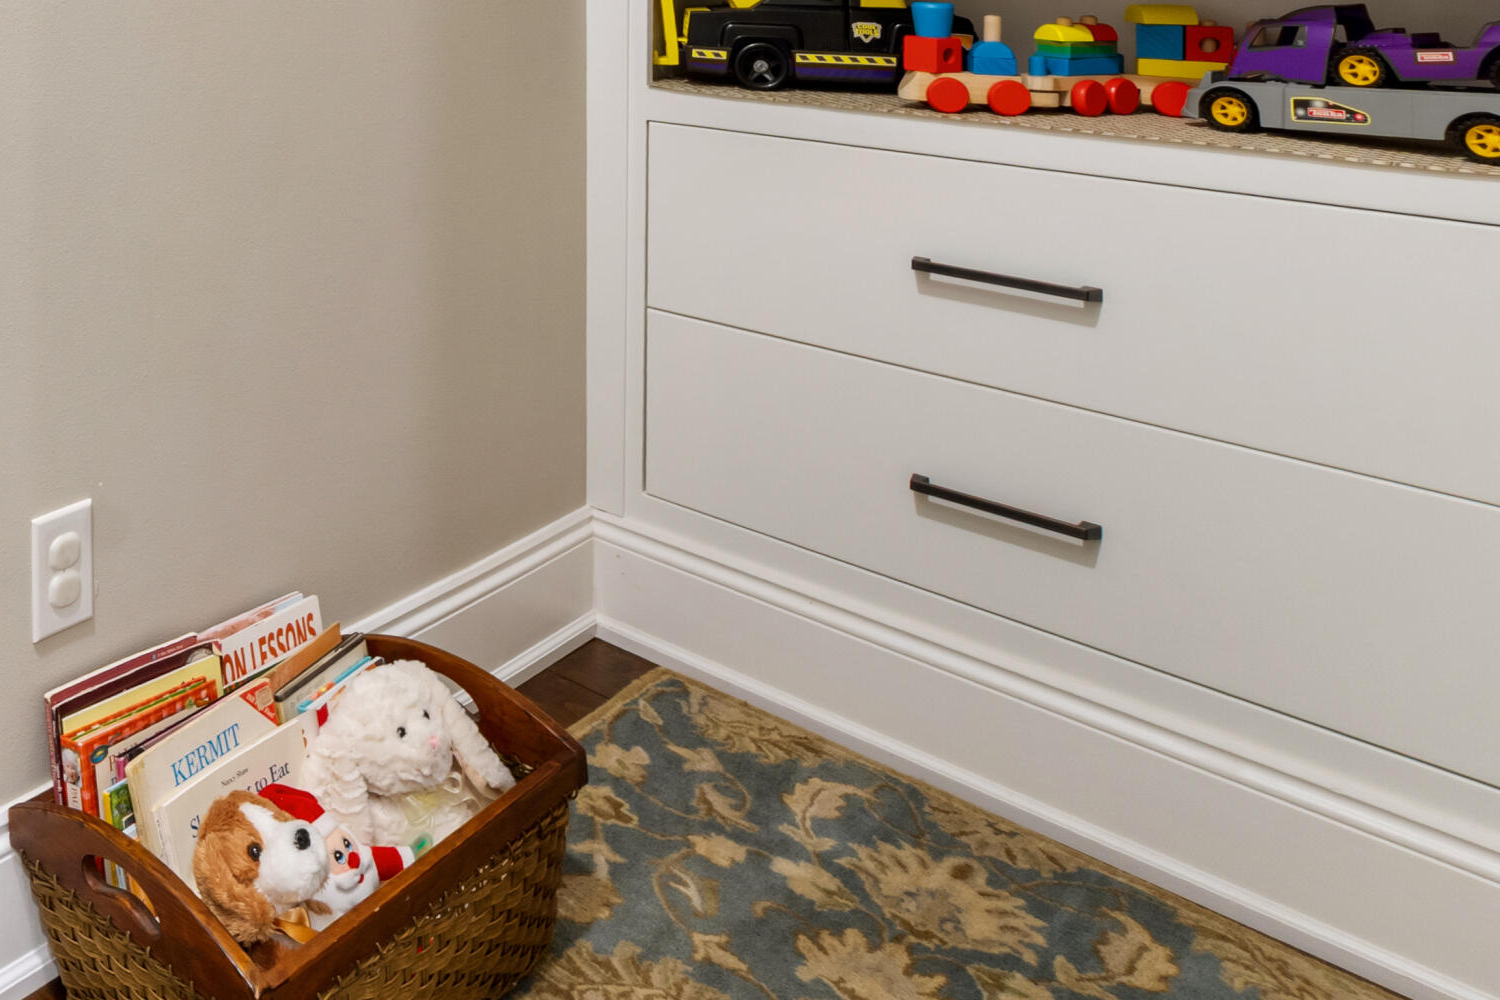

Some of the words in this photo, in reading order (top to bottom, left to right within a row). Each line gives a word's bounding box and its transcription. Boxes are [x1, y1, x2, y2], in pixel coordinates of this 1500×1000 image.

[170, 722, 240, 787] KERMIT
[255, 777, 269, 793] to
[269, 762, 290, 783] Eat
